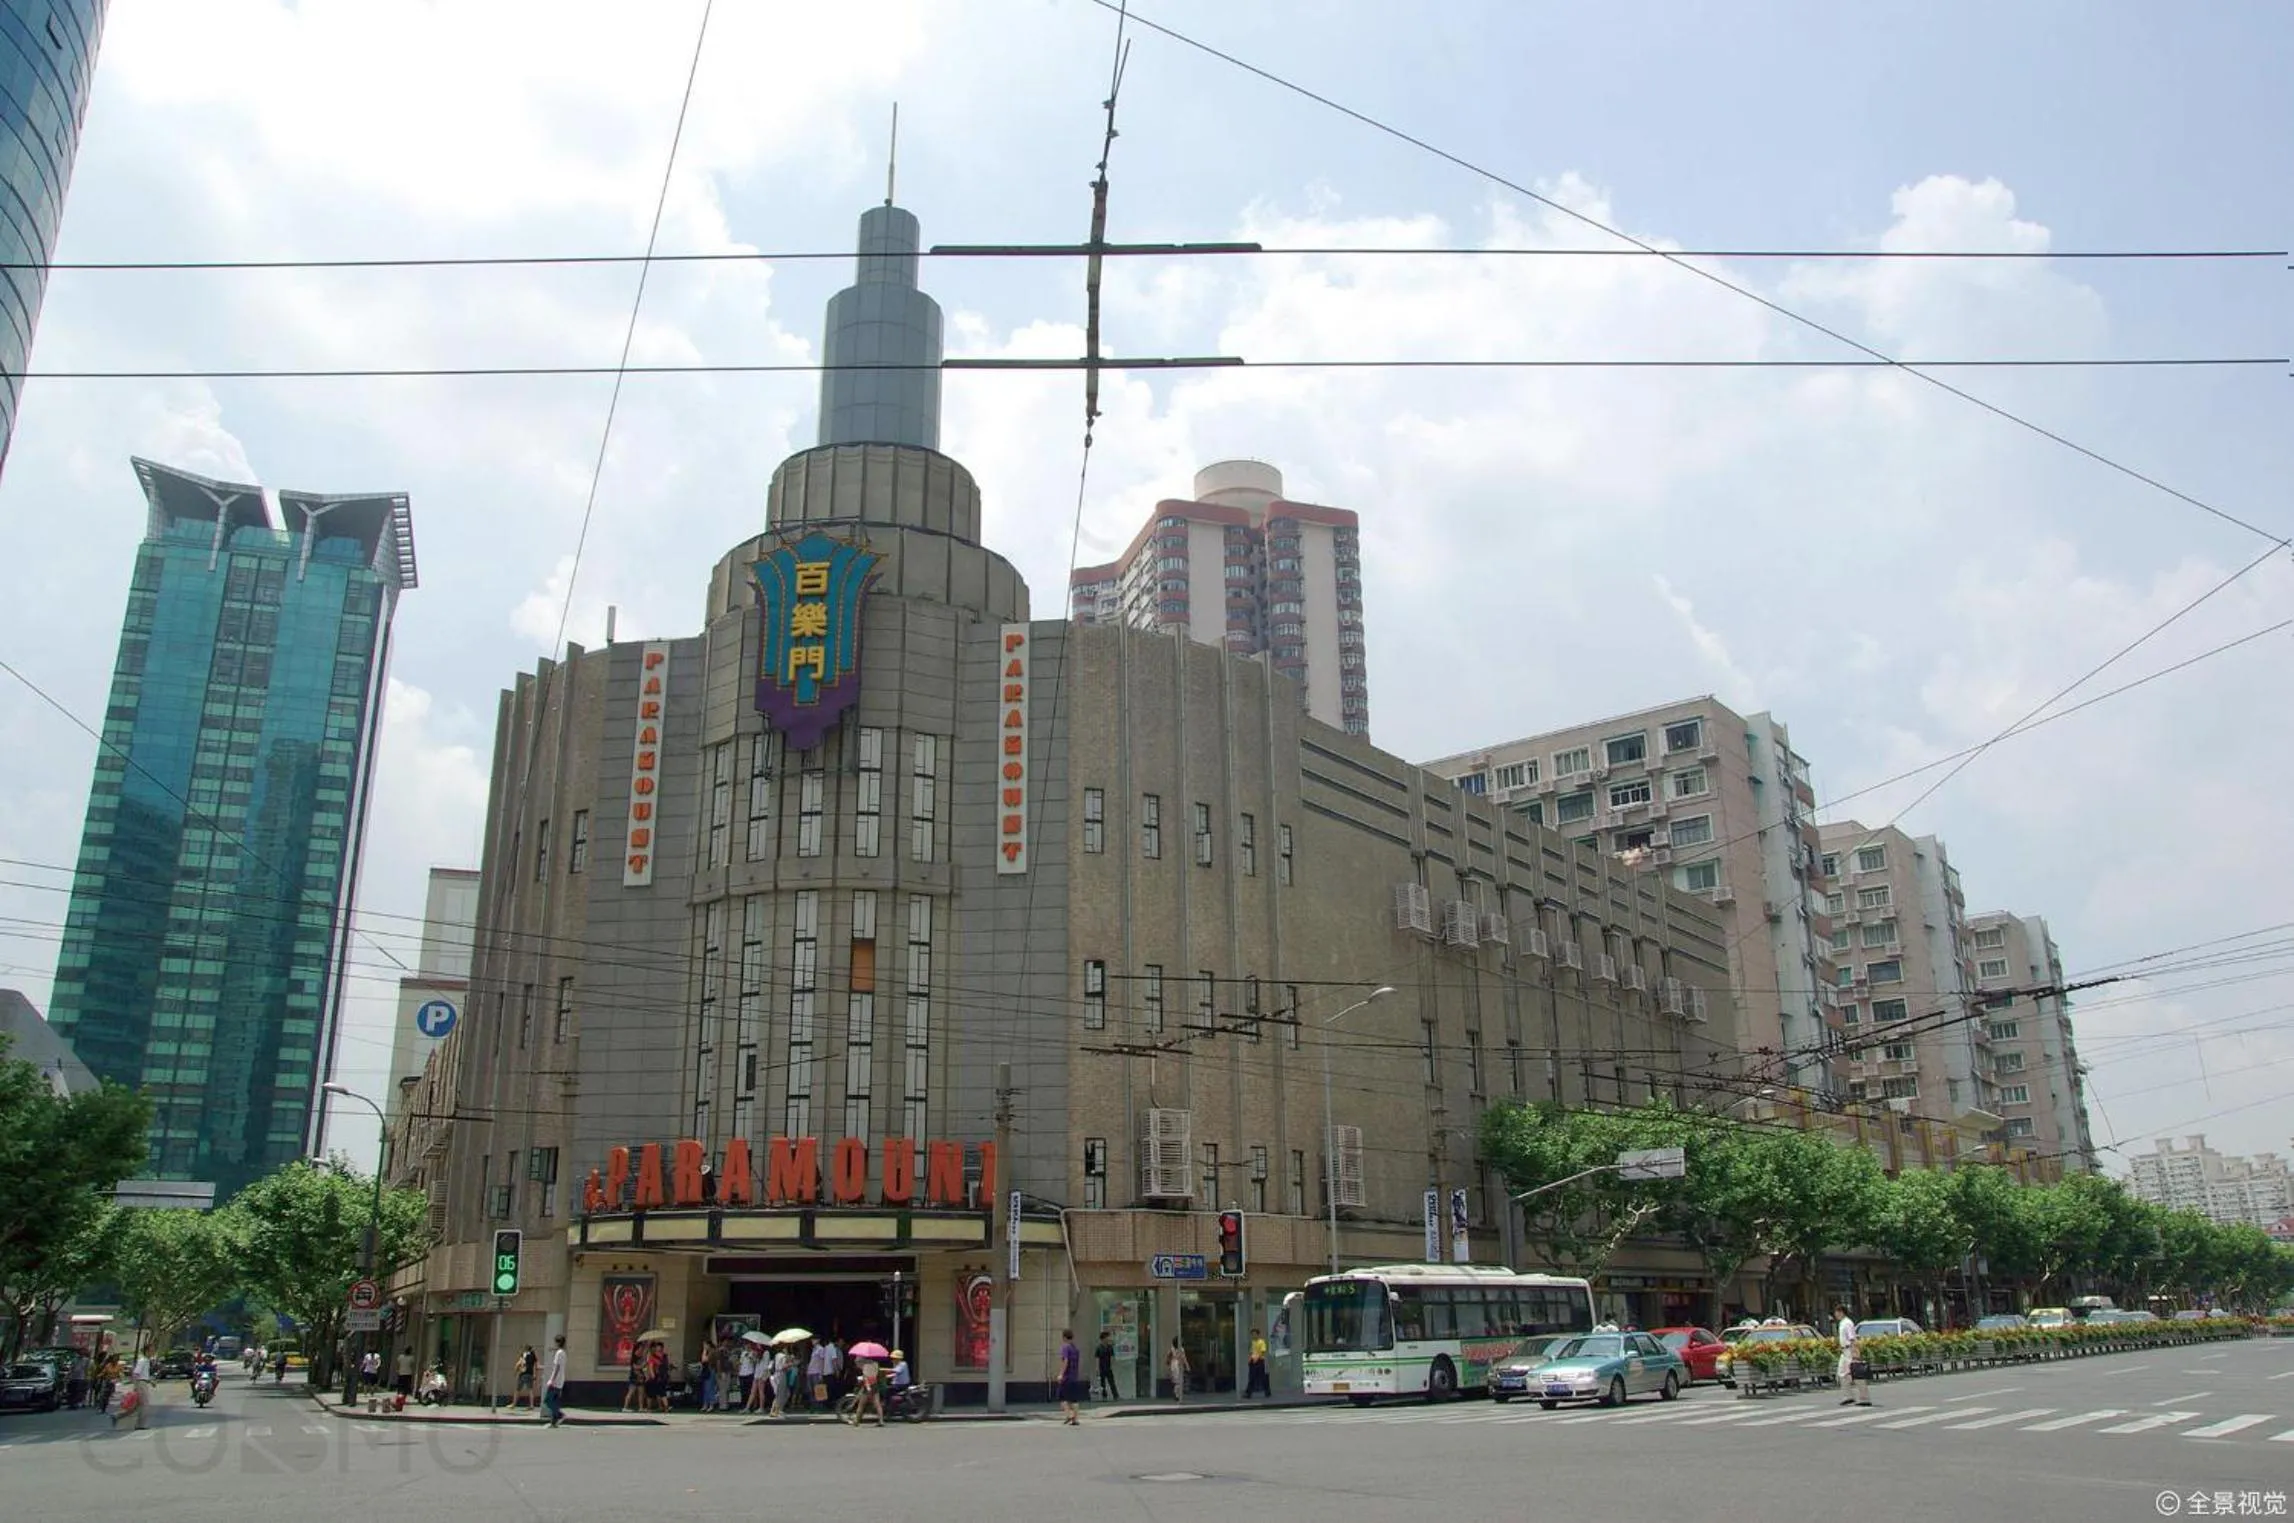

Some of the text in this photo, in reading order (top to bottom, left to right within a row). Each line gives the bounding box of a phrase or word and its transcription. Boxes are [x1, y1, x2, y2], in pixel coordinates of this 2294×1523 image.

[788, 562, 831, 681] 百樂門
[628, 652, 665, 875] PARAMOUNT
[1002, 634, 1025, 863] PARAMOUNT
[426, 1005, 450, 1032] P
[497, 1254, 516, 1271] 06
